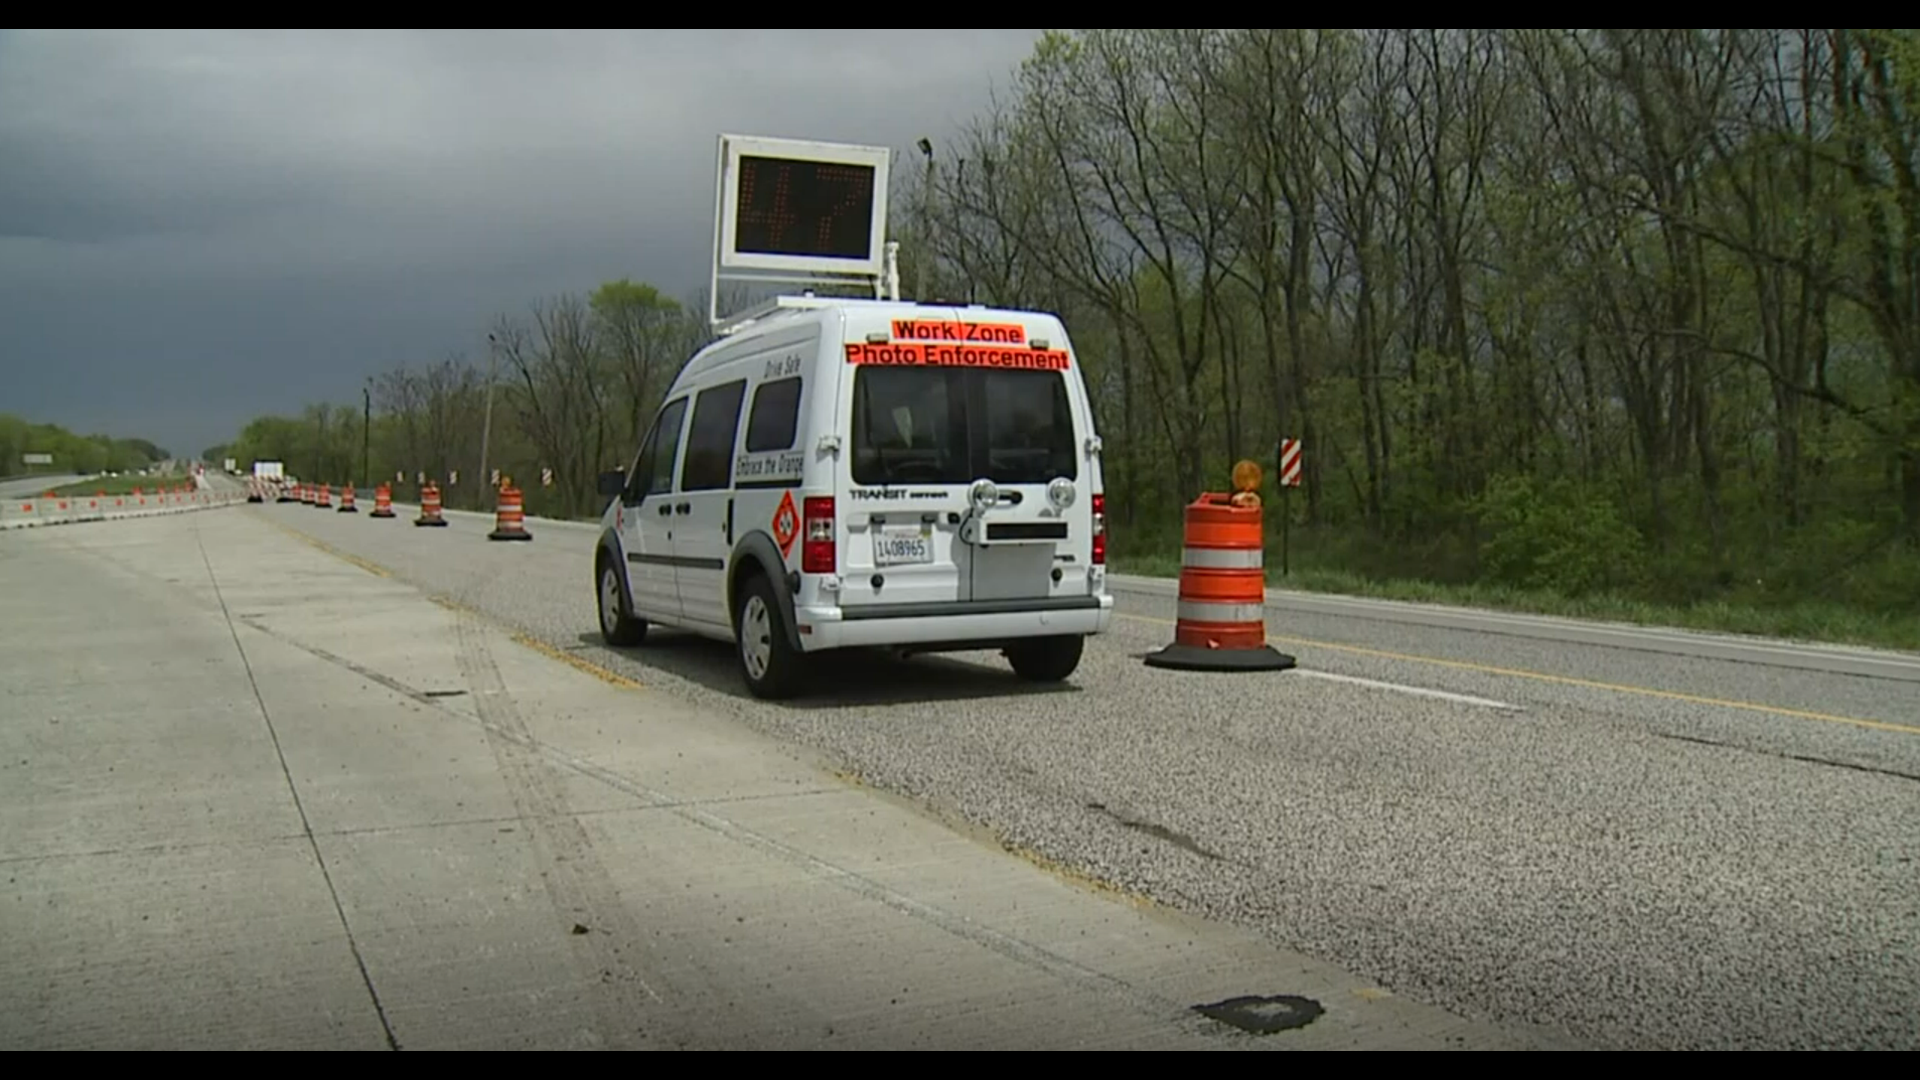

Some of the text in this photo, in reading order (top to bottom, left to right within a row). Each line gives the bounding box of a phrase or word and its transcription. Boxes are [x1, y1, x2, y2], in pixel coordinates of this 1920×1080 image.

[737, 162, 872, 251] 47
[895, 320, 1022, 344] Work Zone
[763, 354, 802, 380] Drive Safe
[844, 343, 1070, 371] Photo Enforcement
[765, 457, 777, 474] the
[778, 453, 804, 479] Orange
[849, 490, 908, 500] TRANSIT
[877, 539, 925, 557] 1408965
